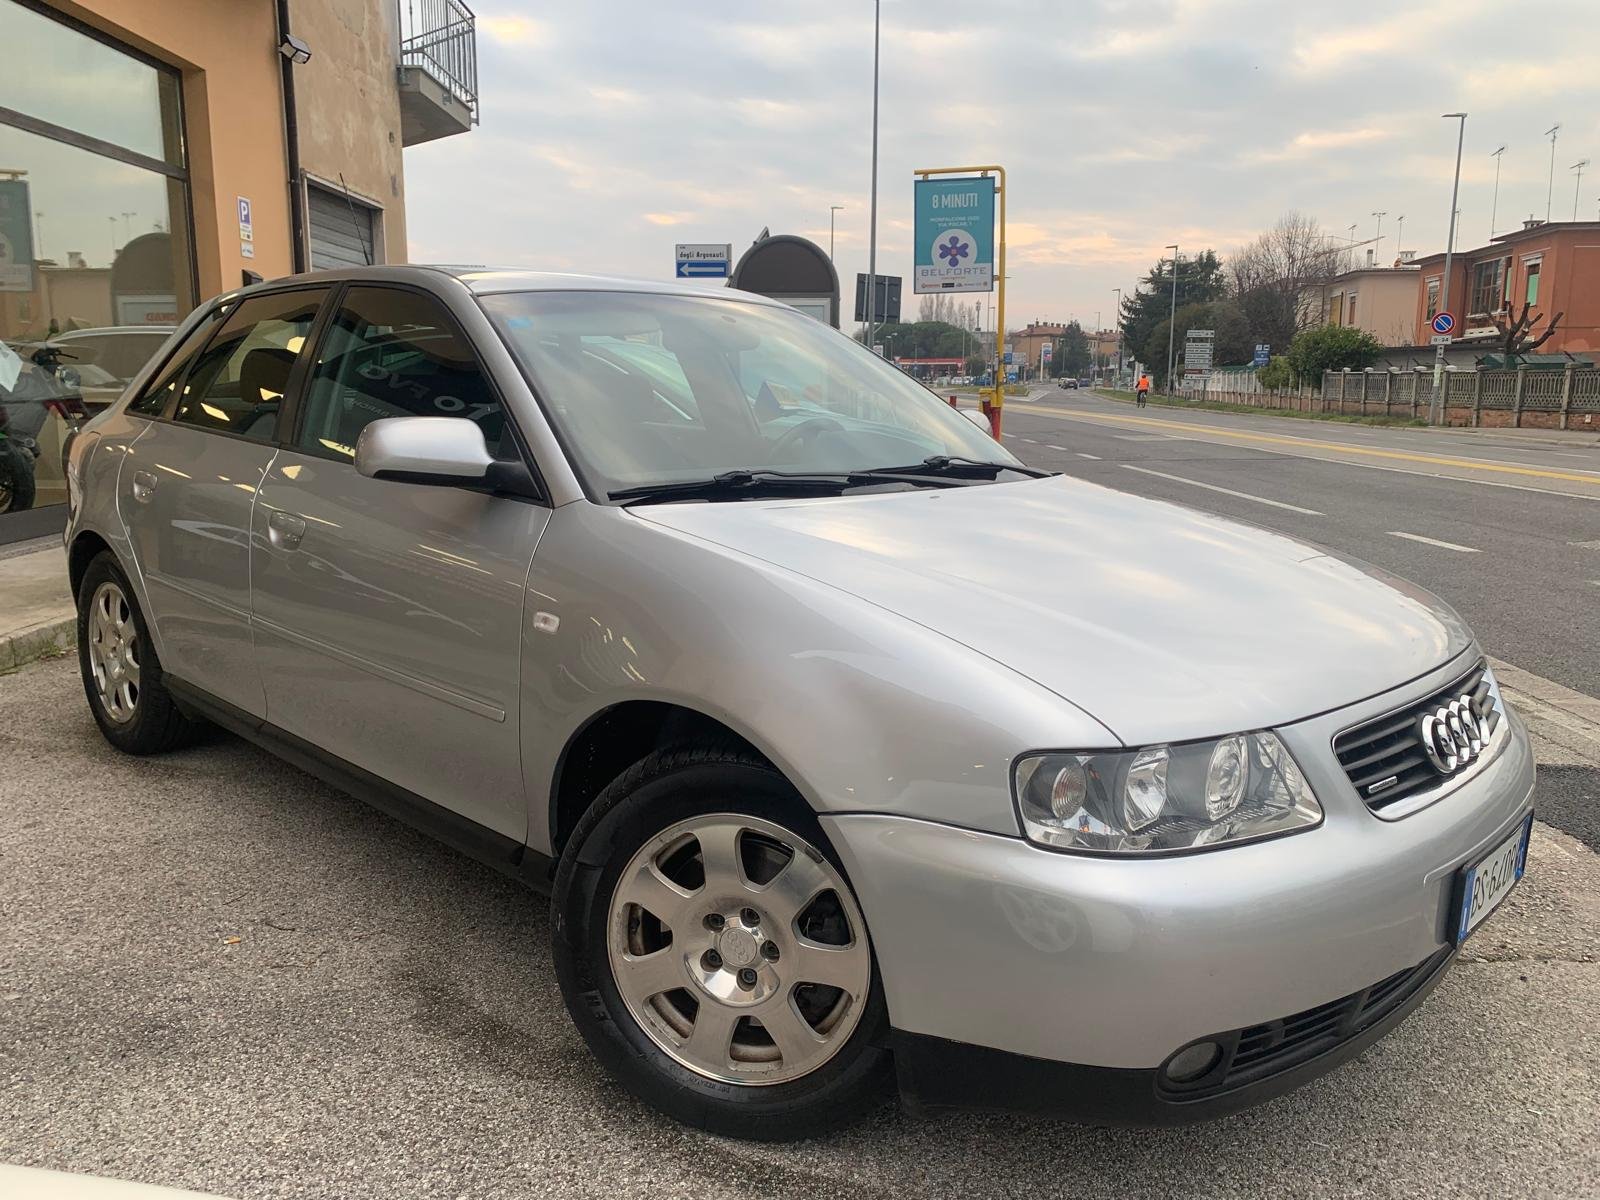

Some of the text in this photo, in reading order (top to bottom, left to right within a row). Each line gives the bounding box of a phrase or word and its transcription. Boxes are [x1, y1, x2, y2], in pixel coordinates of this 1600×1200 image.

[932, 193, 978, 209] 8 MINUTI
[240, 201, 248, 221] P
[680, 251, 725, 260] degli Argonauti
[921, 267, 987, 277] BELFORTE
